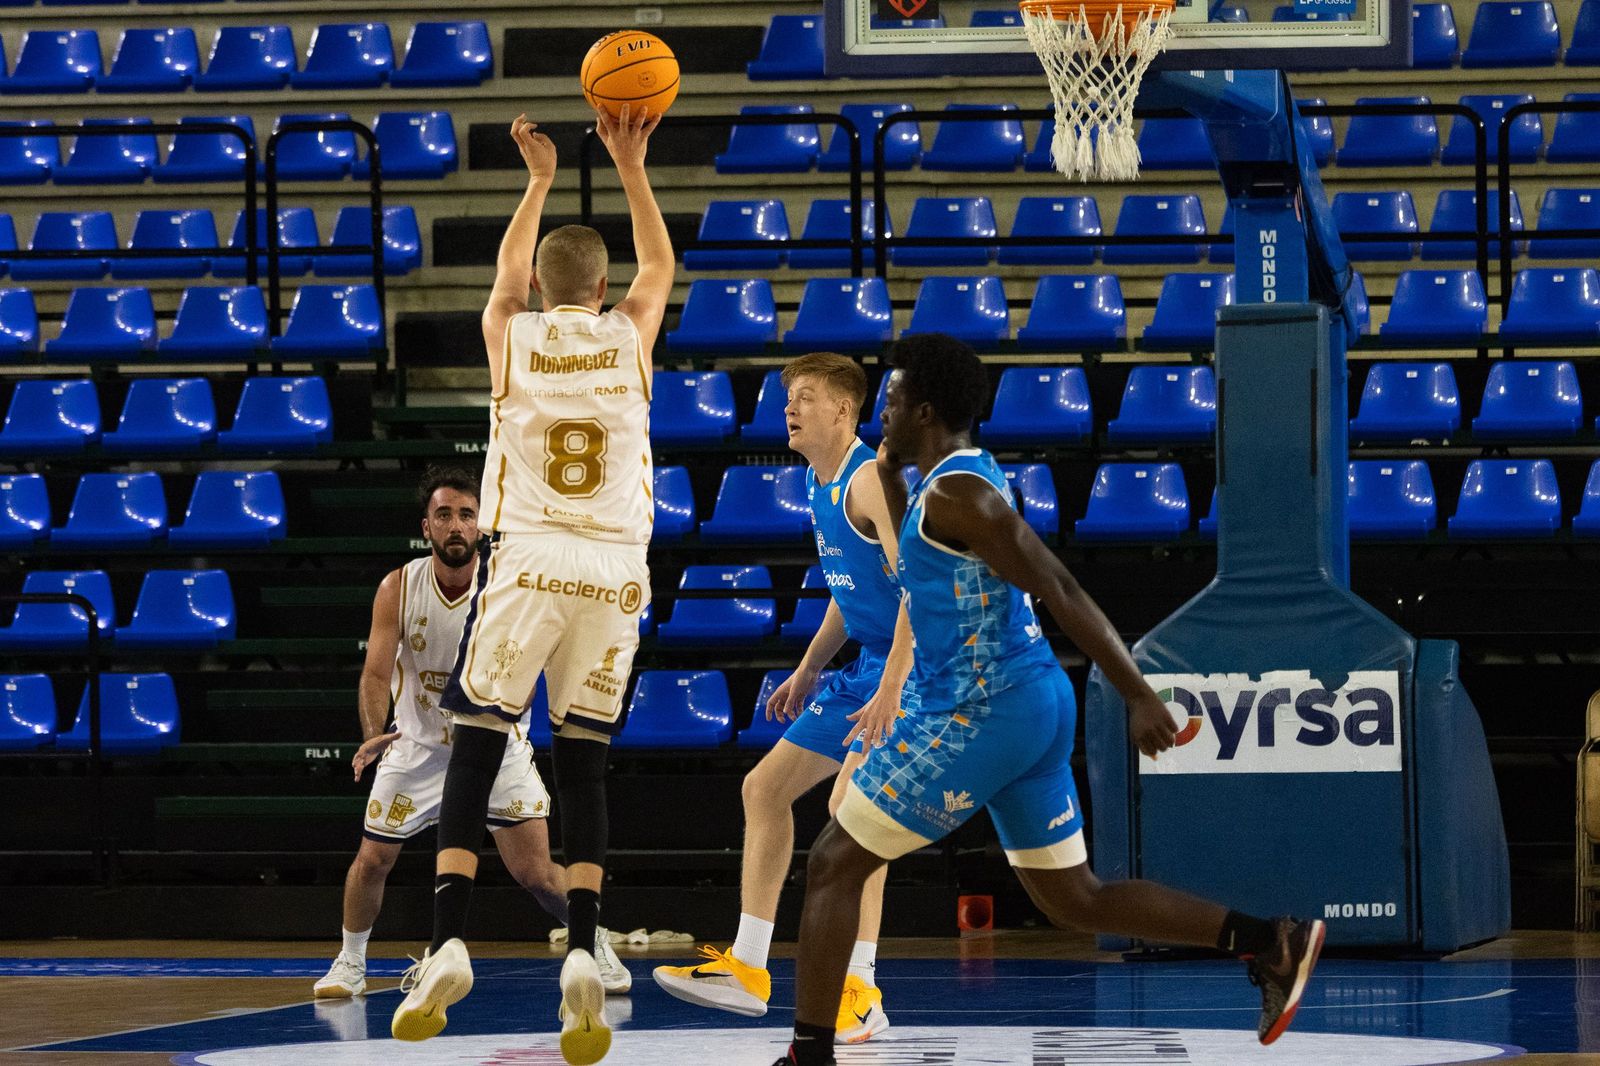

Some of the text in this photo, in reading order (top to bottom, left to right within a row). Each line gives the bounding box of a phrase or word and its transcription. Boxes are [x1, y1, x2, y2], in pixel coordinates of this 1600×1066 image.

[1260, 228, 1277, 303] MONDO
[529, 348, 619, 374] DOMINGUEZ
[594, 385, 628, 396] RMD
[543, 417, 609, 500] 8
[517, 572, 618, 603] E.Leclerc
[582, 678, 618, 697] ARIAS
[305, 748, 340, 758] FILA 1
[1324, 902, 1397, 919] MONDO
